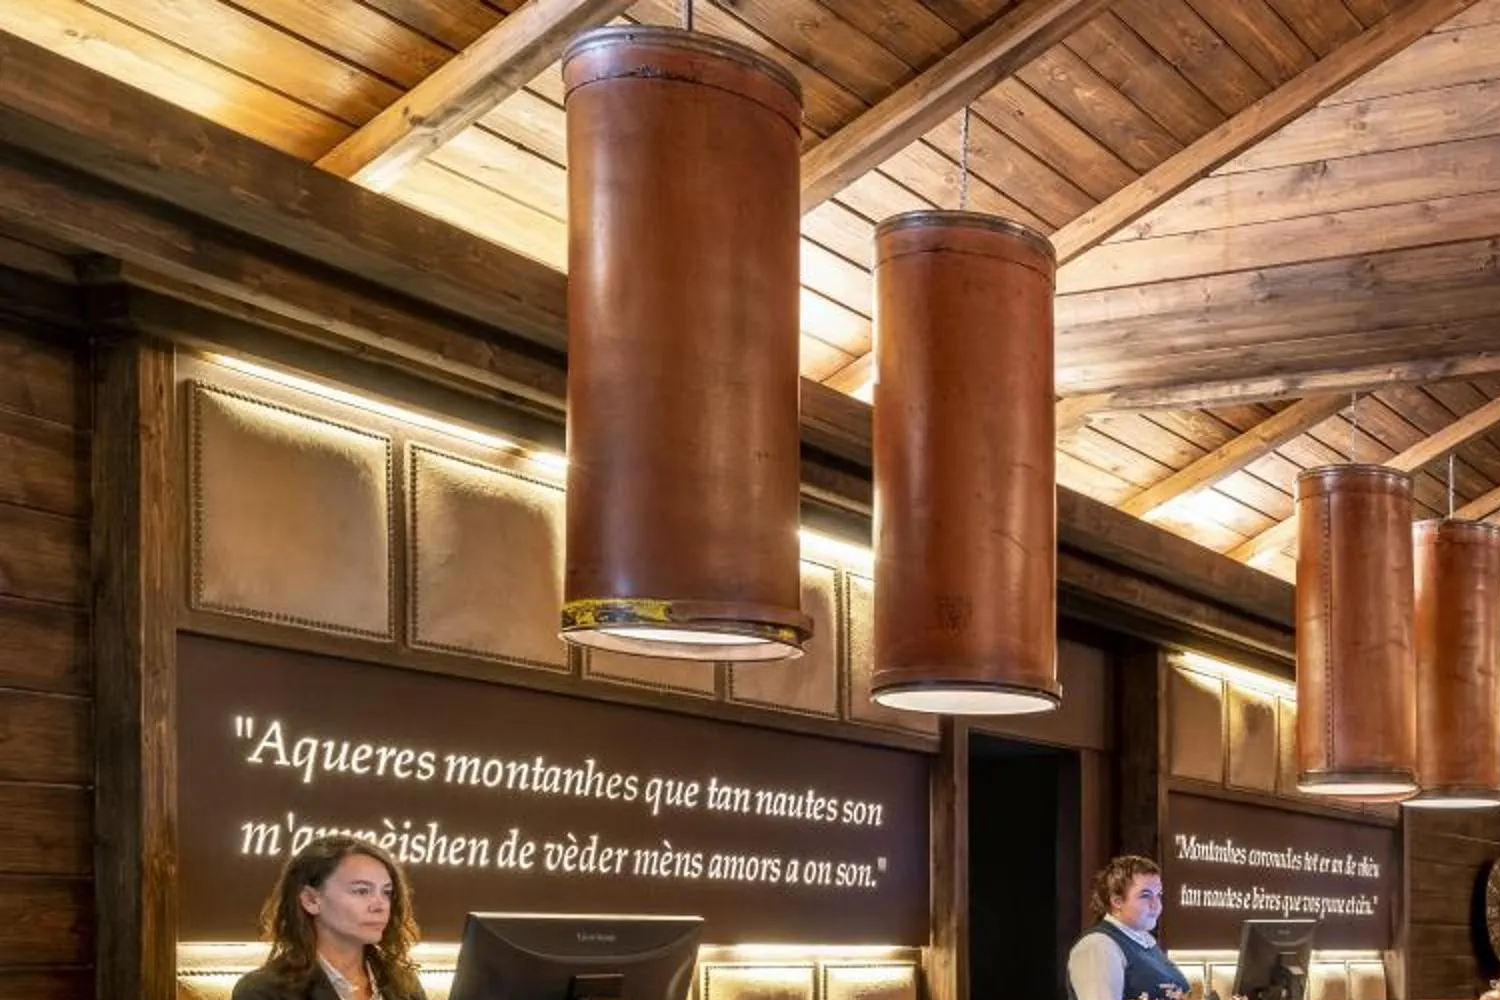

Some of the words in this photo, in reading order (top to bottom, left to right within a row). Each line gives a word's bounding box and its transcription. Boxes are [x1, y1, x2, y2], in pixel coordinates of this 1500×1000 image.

[235, 715, 436, 784] "Aqueres
[444, 752, 639, 801] montanhes
[645, 776, 699, 816] que
[707, 777, 750, 813] tan
[755, 789, 838, 822] nautes
[842, 800, 883, 826] son
[499, 828, 536, 869] de
[544, 832, 628, 875] vèder
[633, 839, 703, 879] mèns
[708, 853, 781, 882] amors
[785, 858, 800, 883] a
[803, 860, 832, 885] on
